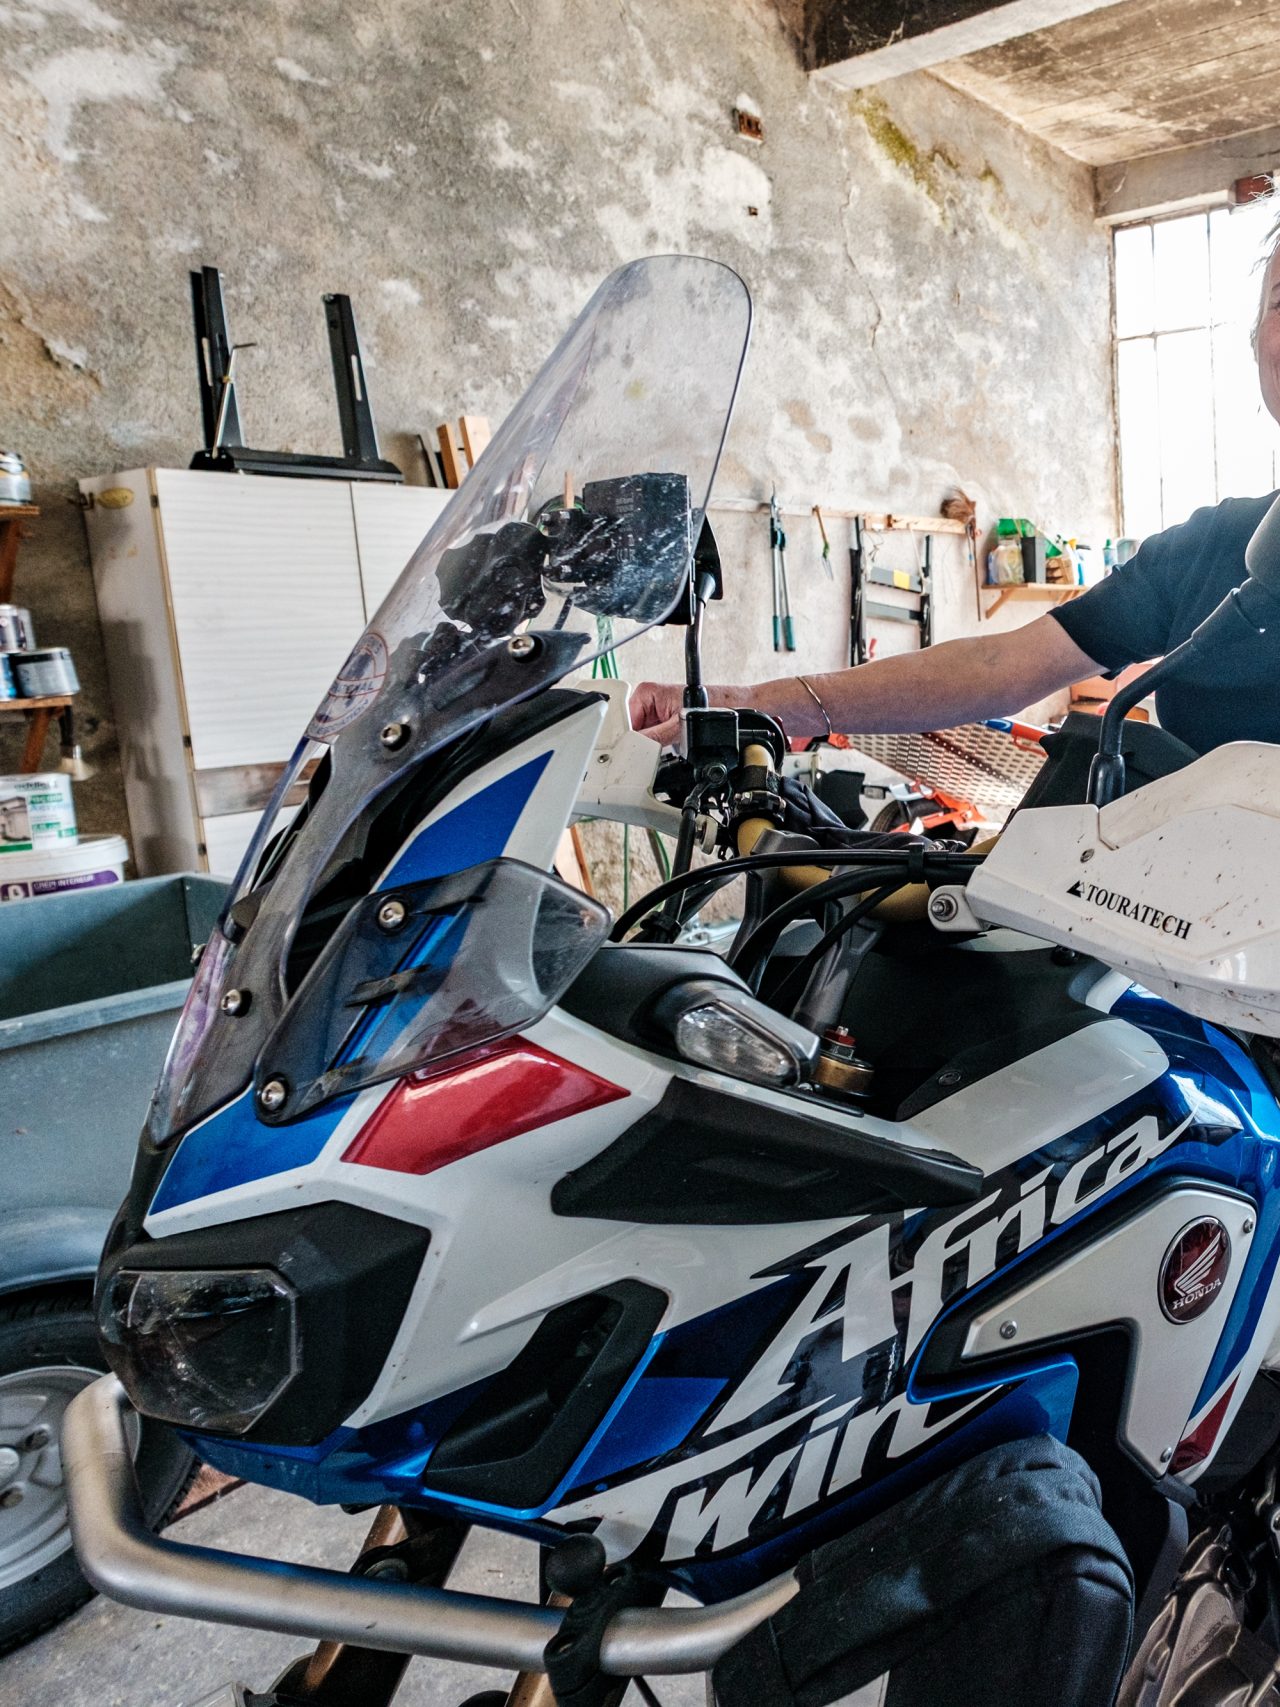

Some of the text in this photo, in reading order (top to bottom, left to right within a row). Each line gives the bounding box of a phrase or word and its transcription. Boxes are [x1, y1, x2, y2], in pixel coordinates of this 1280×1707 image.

[1086, 884, 1192, 940] TOURATECH
[702, 1103, 1200, 1437] Africa
[1172, 1278, 1222, 1310] HONDA
